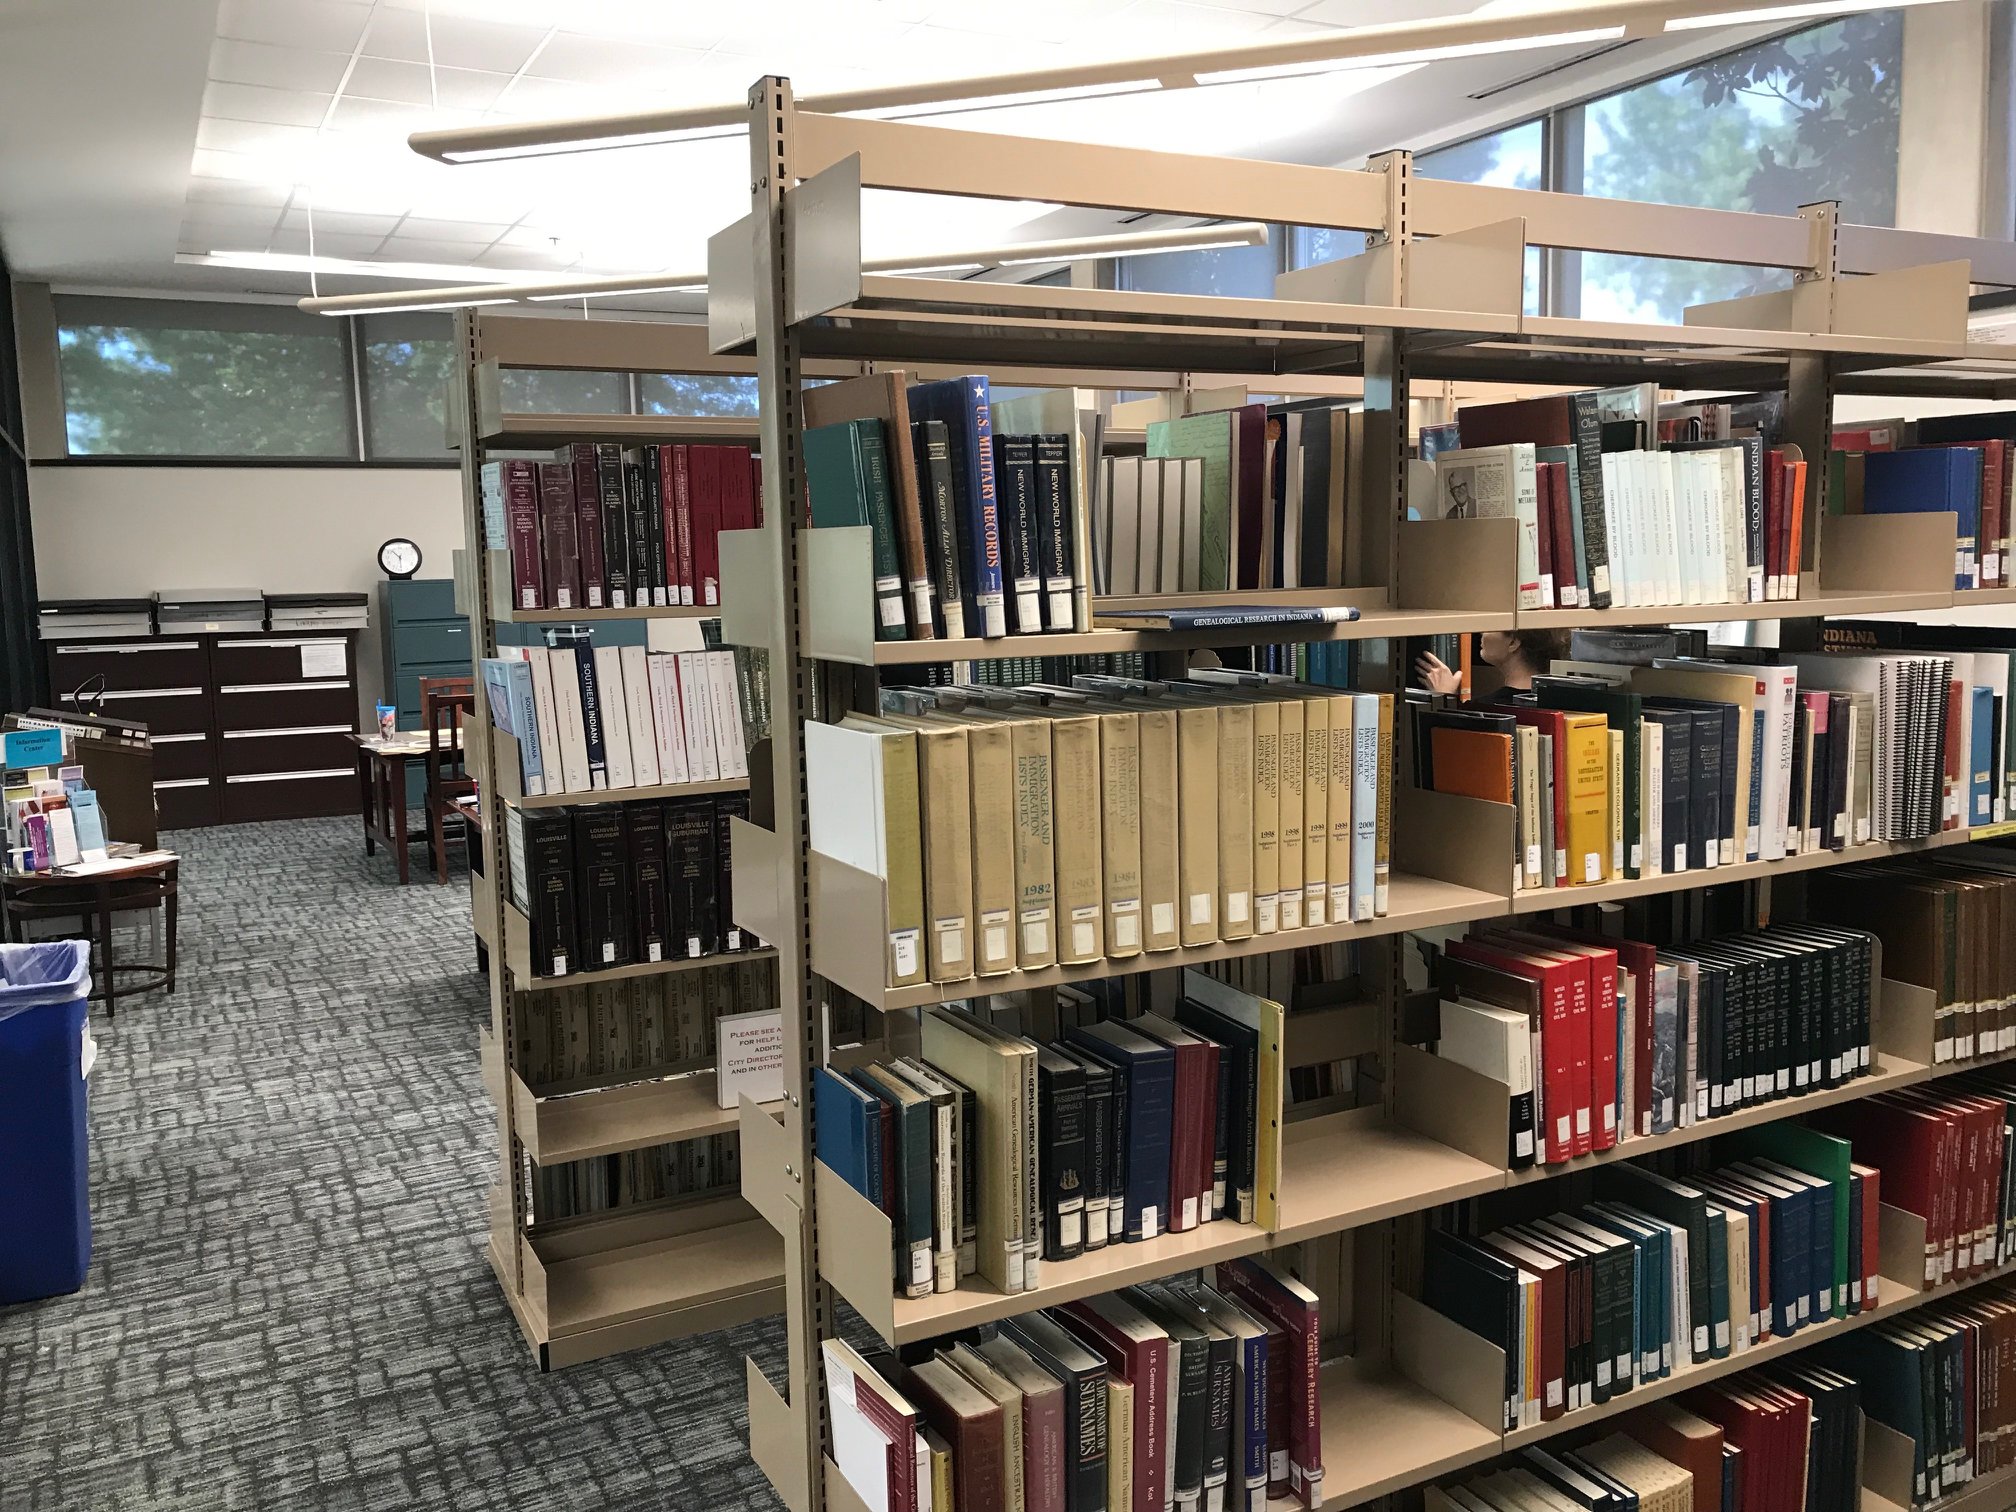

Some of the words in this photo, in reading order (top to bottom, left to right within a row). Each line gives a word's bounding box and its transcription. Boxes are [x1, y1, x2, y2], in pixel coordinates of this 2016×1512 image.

[976, 404, 988, 431] U.S.
[978, 435, 994, 500] MILITARY
[1017, 469, 1025, 492] NEW
[1050, 468, 1059, 491] NEW
[1752, 442, 1760, 486] INDIAN
[1018, 492, 1027, 528] WORLD
[1052, 492, 1061, 527] WORLD
[983, 505, 999, 568] RECORDS
[1194, 616, 1243, 626] GENEALOGICAL
[1244, 615, 1277, 624] RESEARCH
[1286, 613, 1313, 621] INDIANA
[583, 663, 595, 709] SOUTHERN
[16, 737, 51, 745] Information
[524, 696, 534, 732] SOUTHERN
[529, 732, 538, 759] INDIANA
[588, 710, 598, 745] INDIANA
[1781, 713, 1789, 770] PATRIOTS
[1019, 756, 1028, 786] LISTS
[1039, 755, 1049, 817] PASSENGER
[1020, 790, 1029, 827] INDEX
[1028, 756, 1040, 836] IMMIGRATION
[536, 834, 567, 844] LOUISVILLE
[672, 821, 709, 830] LOUISVILLE
[1042, 820, 1050, 845] AND
[1358, 821, 1374, 829] 2000
[1024, 883, 1051, 896] 1982
[730, 1030, 760, 1038] PLEASE
[1054, 1092, 1085, 1104] PASSENGER
[1056, 1102, 1083, 1113] ARRIVALS
[1010, 1130, 1018, 1172] Genealogical
[1096, 1154, 1102, 1164] TO
[1097, 1386, 1106, 1434] DICTIONARY
[1210, 1365, 1222, 1427] SURNAMES
[1220, 1365, 1232, 1424] AMERICAN
[1012, 1414, 1020, 1452] ENGLISH
[1079, 1381, 1096, 1456] SURNAMES
[1098, 1436, 1106, 1449] OF
[1122, 1395, 1130, 1482] German-American
